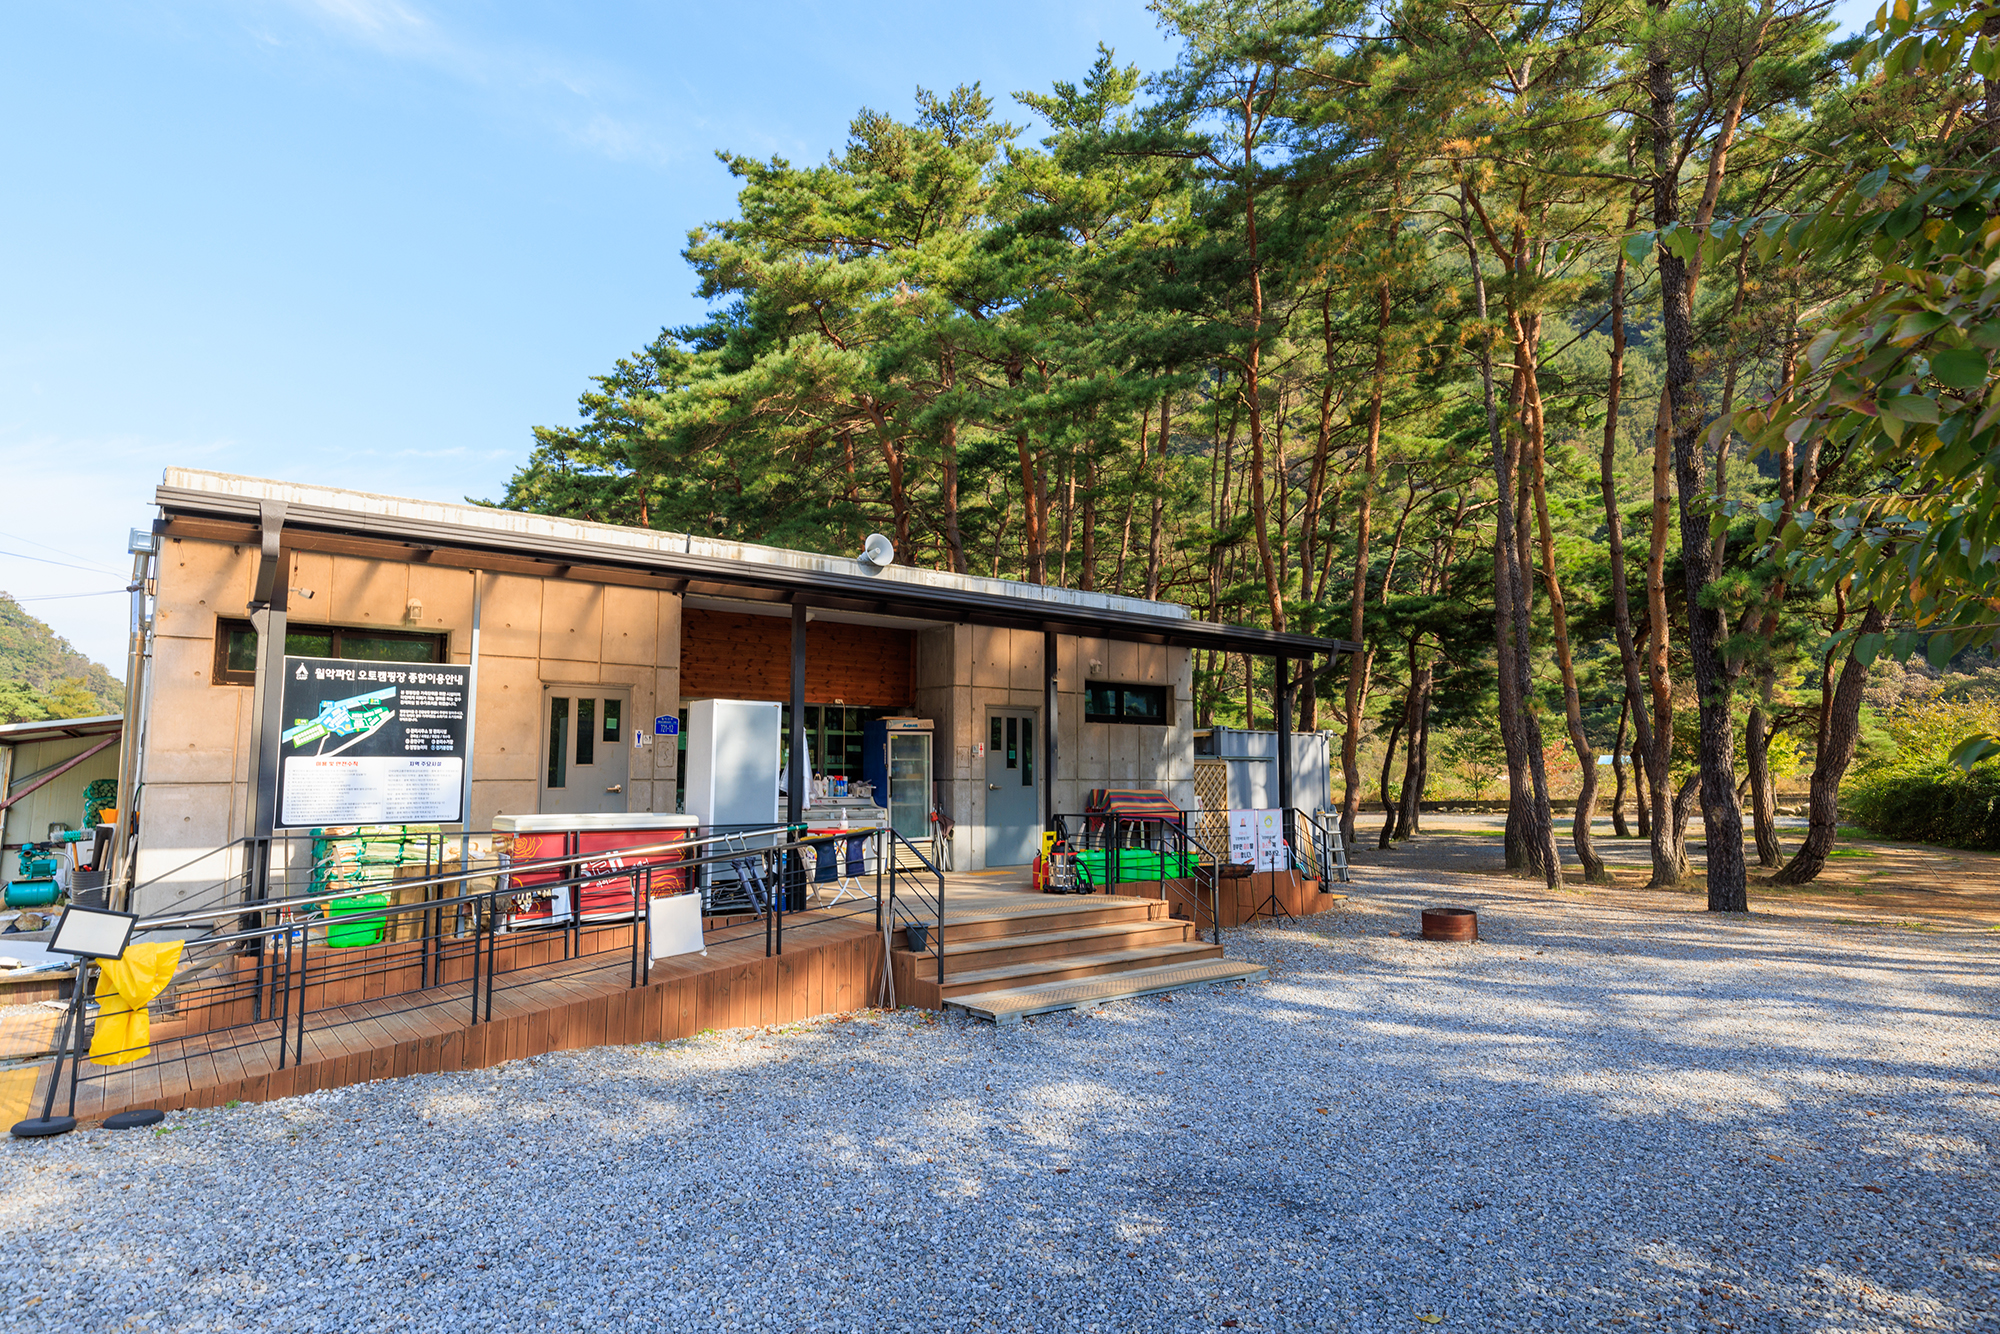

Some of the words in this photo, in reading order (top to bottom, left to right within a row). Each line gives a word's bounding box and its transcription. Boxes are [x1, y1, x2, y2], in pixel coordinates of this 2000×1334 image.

[315, 668, 356, 681] 월악파인
[357, 670, 406, 683] 오토캠핑장
[408, 672, 463, 685] 종합이용안내
